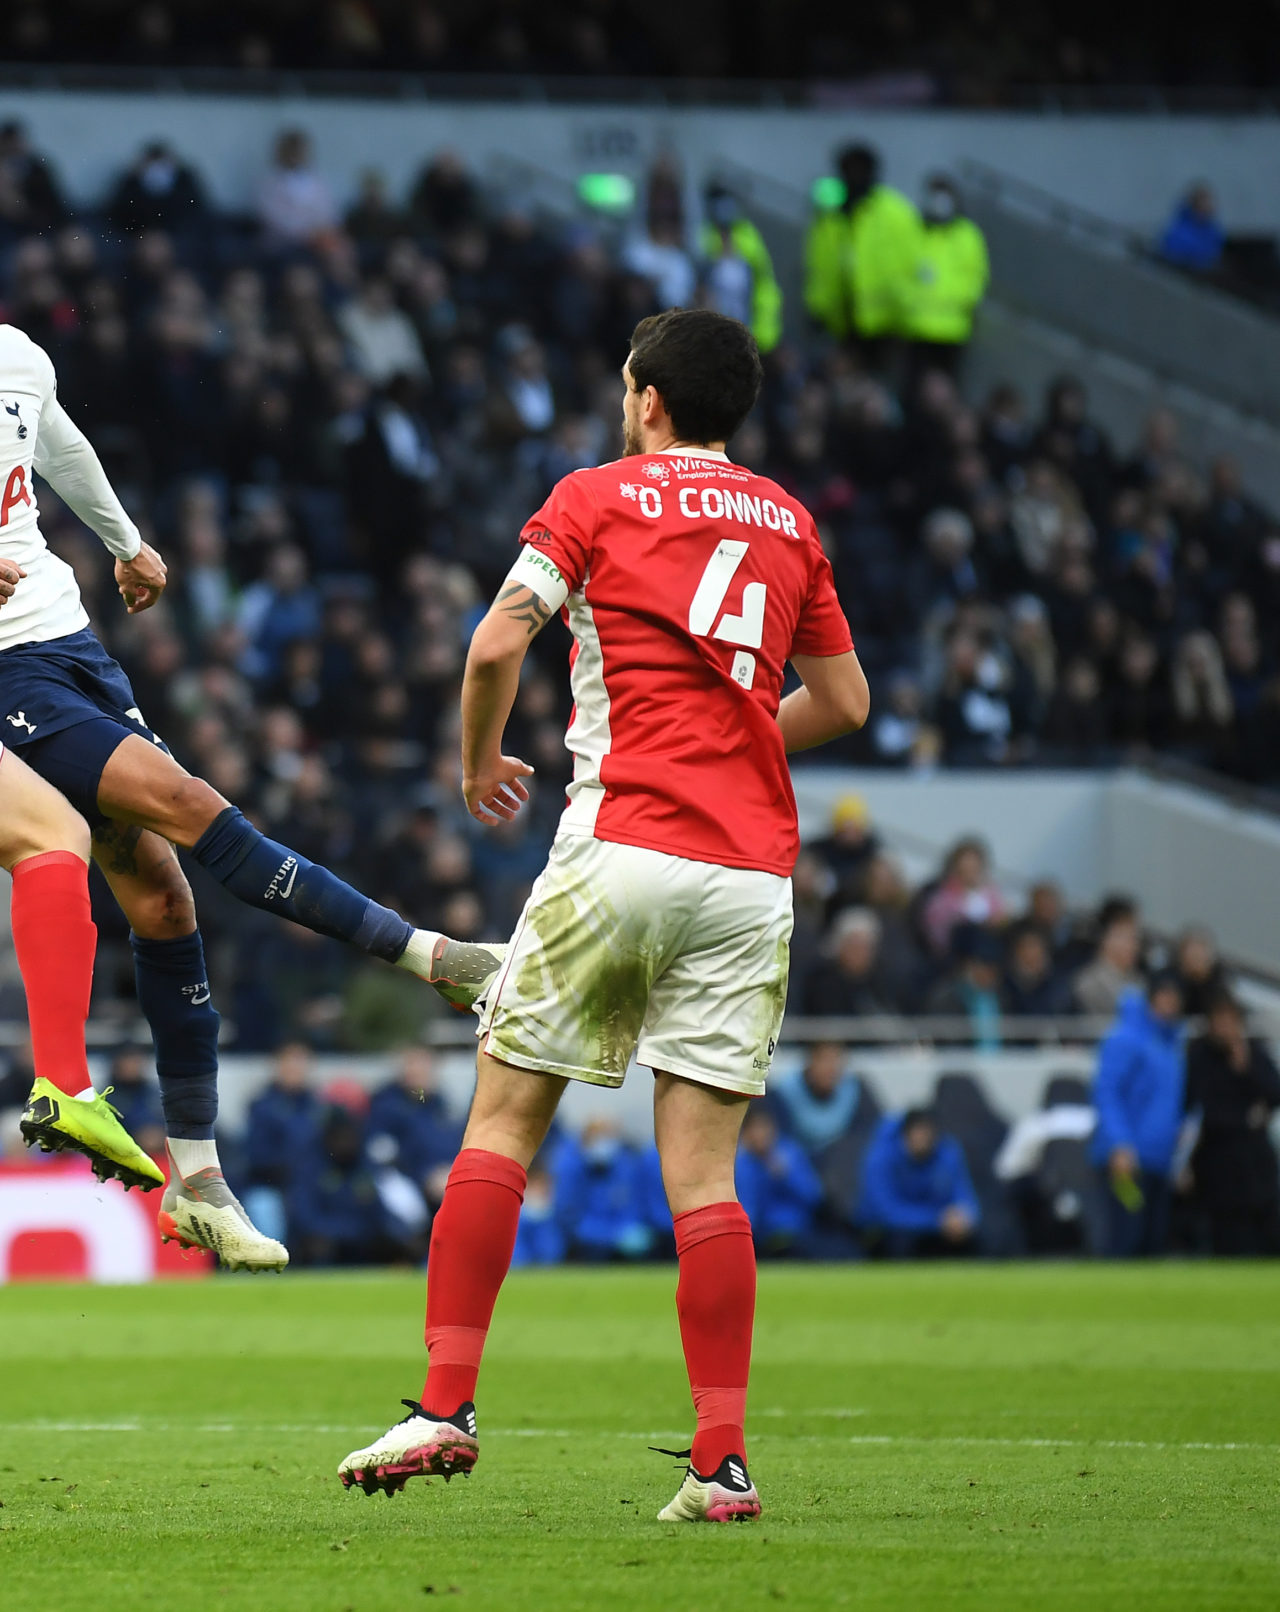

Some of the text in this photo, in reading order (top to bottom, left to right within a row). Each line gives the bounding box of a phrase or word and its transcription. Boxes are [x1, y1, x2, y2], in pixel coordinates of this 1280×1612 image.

[677, 471, 716, 480] Employer
[678, 487, 800, 539] CONNOR
[688, 538, 767, 690] 4
[263, 855, 297, 900] SPURS
